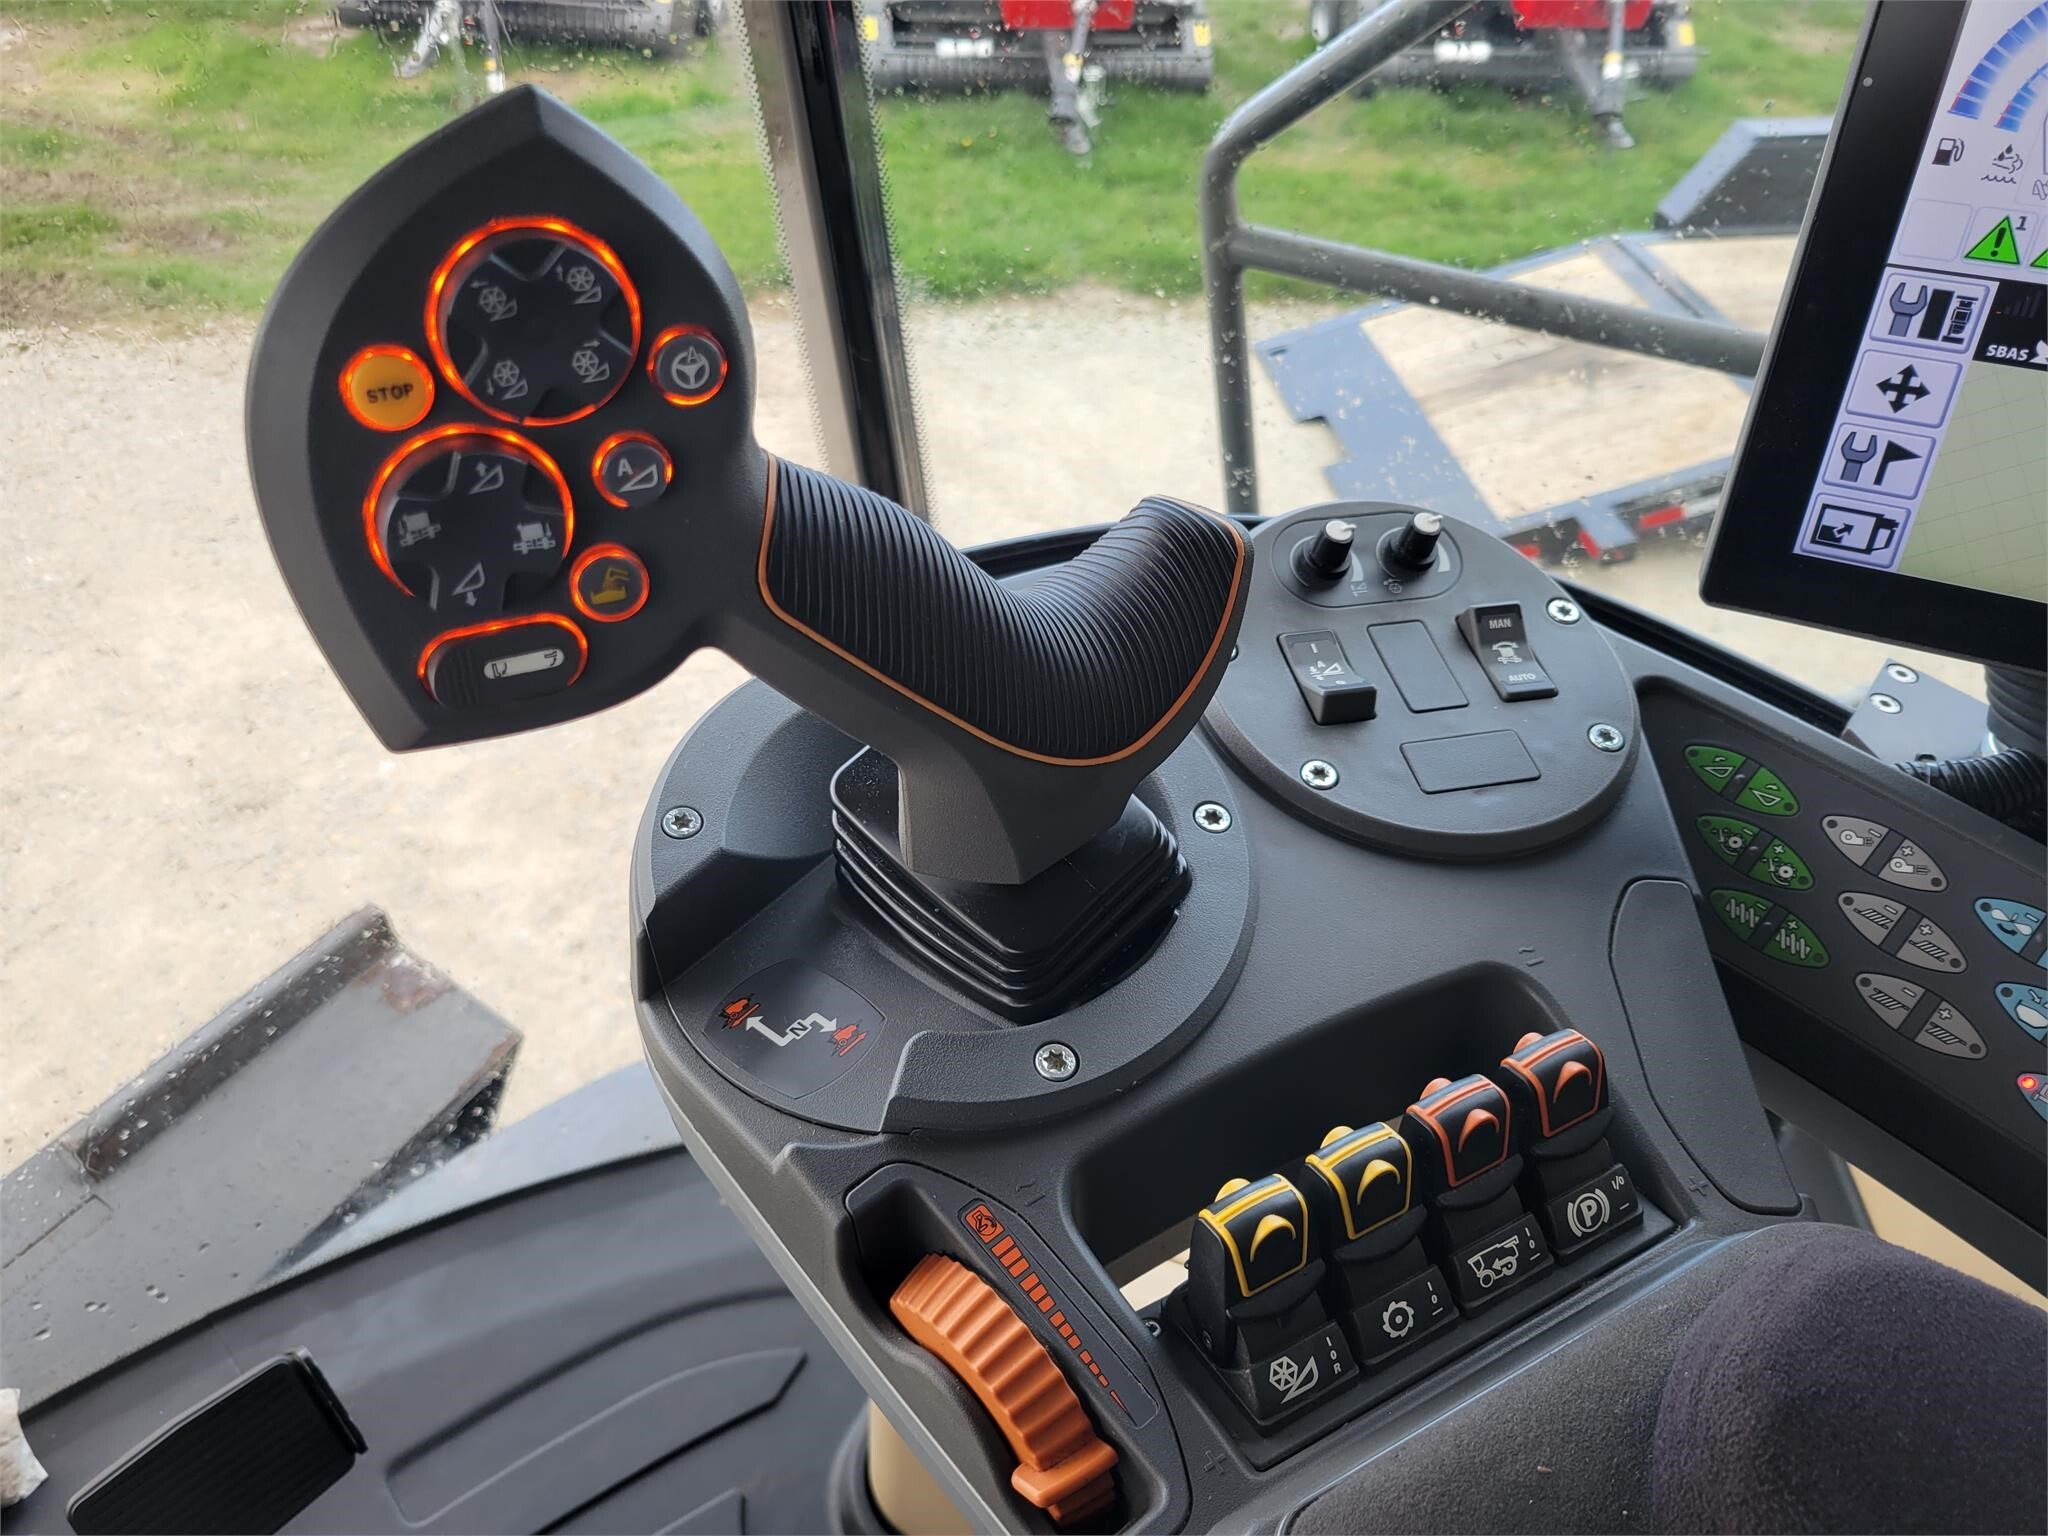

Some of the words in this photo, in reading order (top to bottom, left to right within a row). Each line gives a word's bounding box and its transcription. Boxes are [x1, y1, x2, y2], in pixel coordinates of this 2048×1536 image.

[2015, 216, 2028, 231] 1
[1985, 344, 2030, 361] SBAS
[366, 383, 414, 404] STOP
[616, 458, 634, 477] A
[1488, 617, 1512, 630] MAN
[1508, 672, 1537, 682] AUTO
[1579, 1199, 1598, 1228] P
